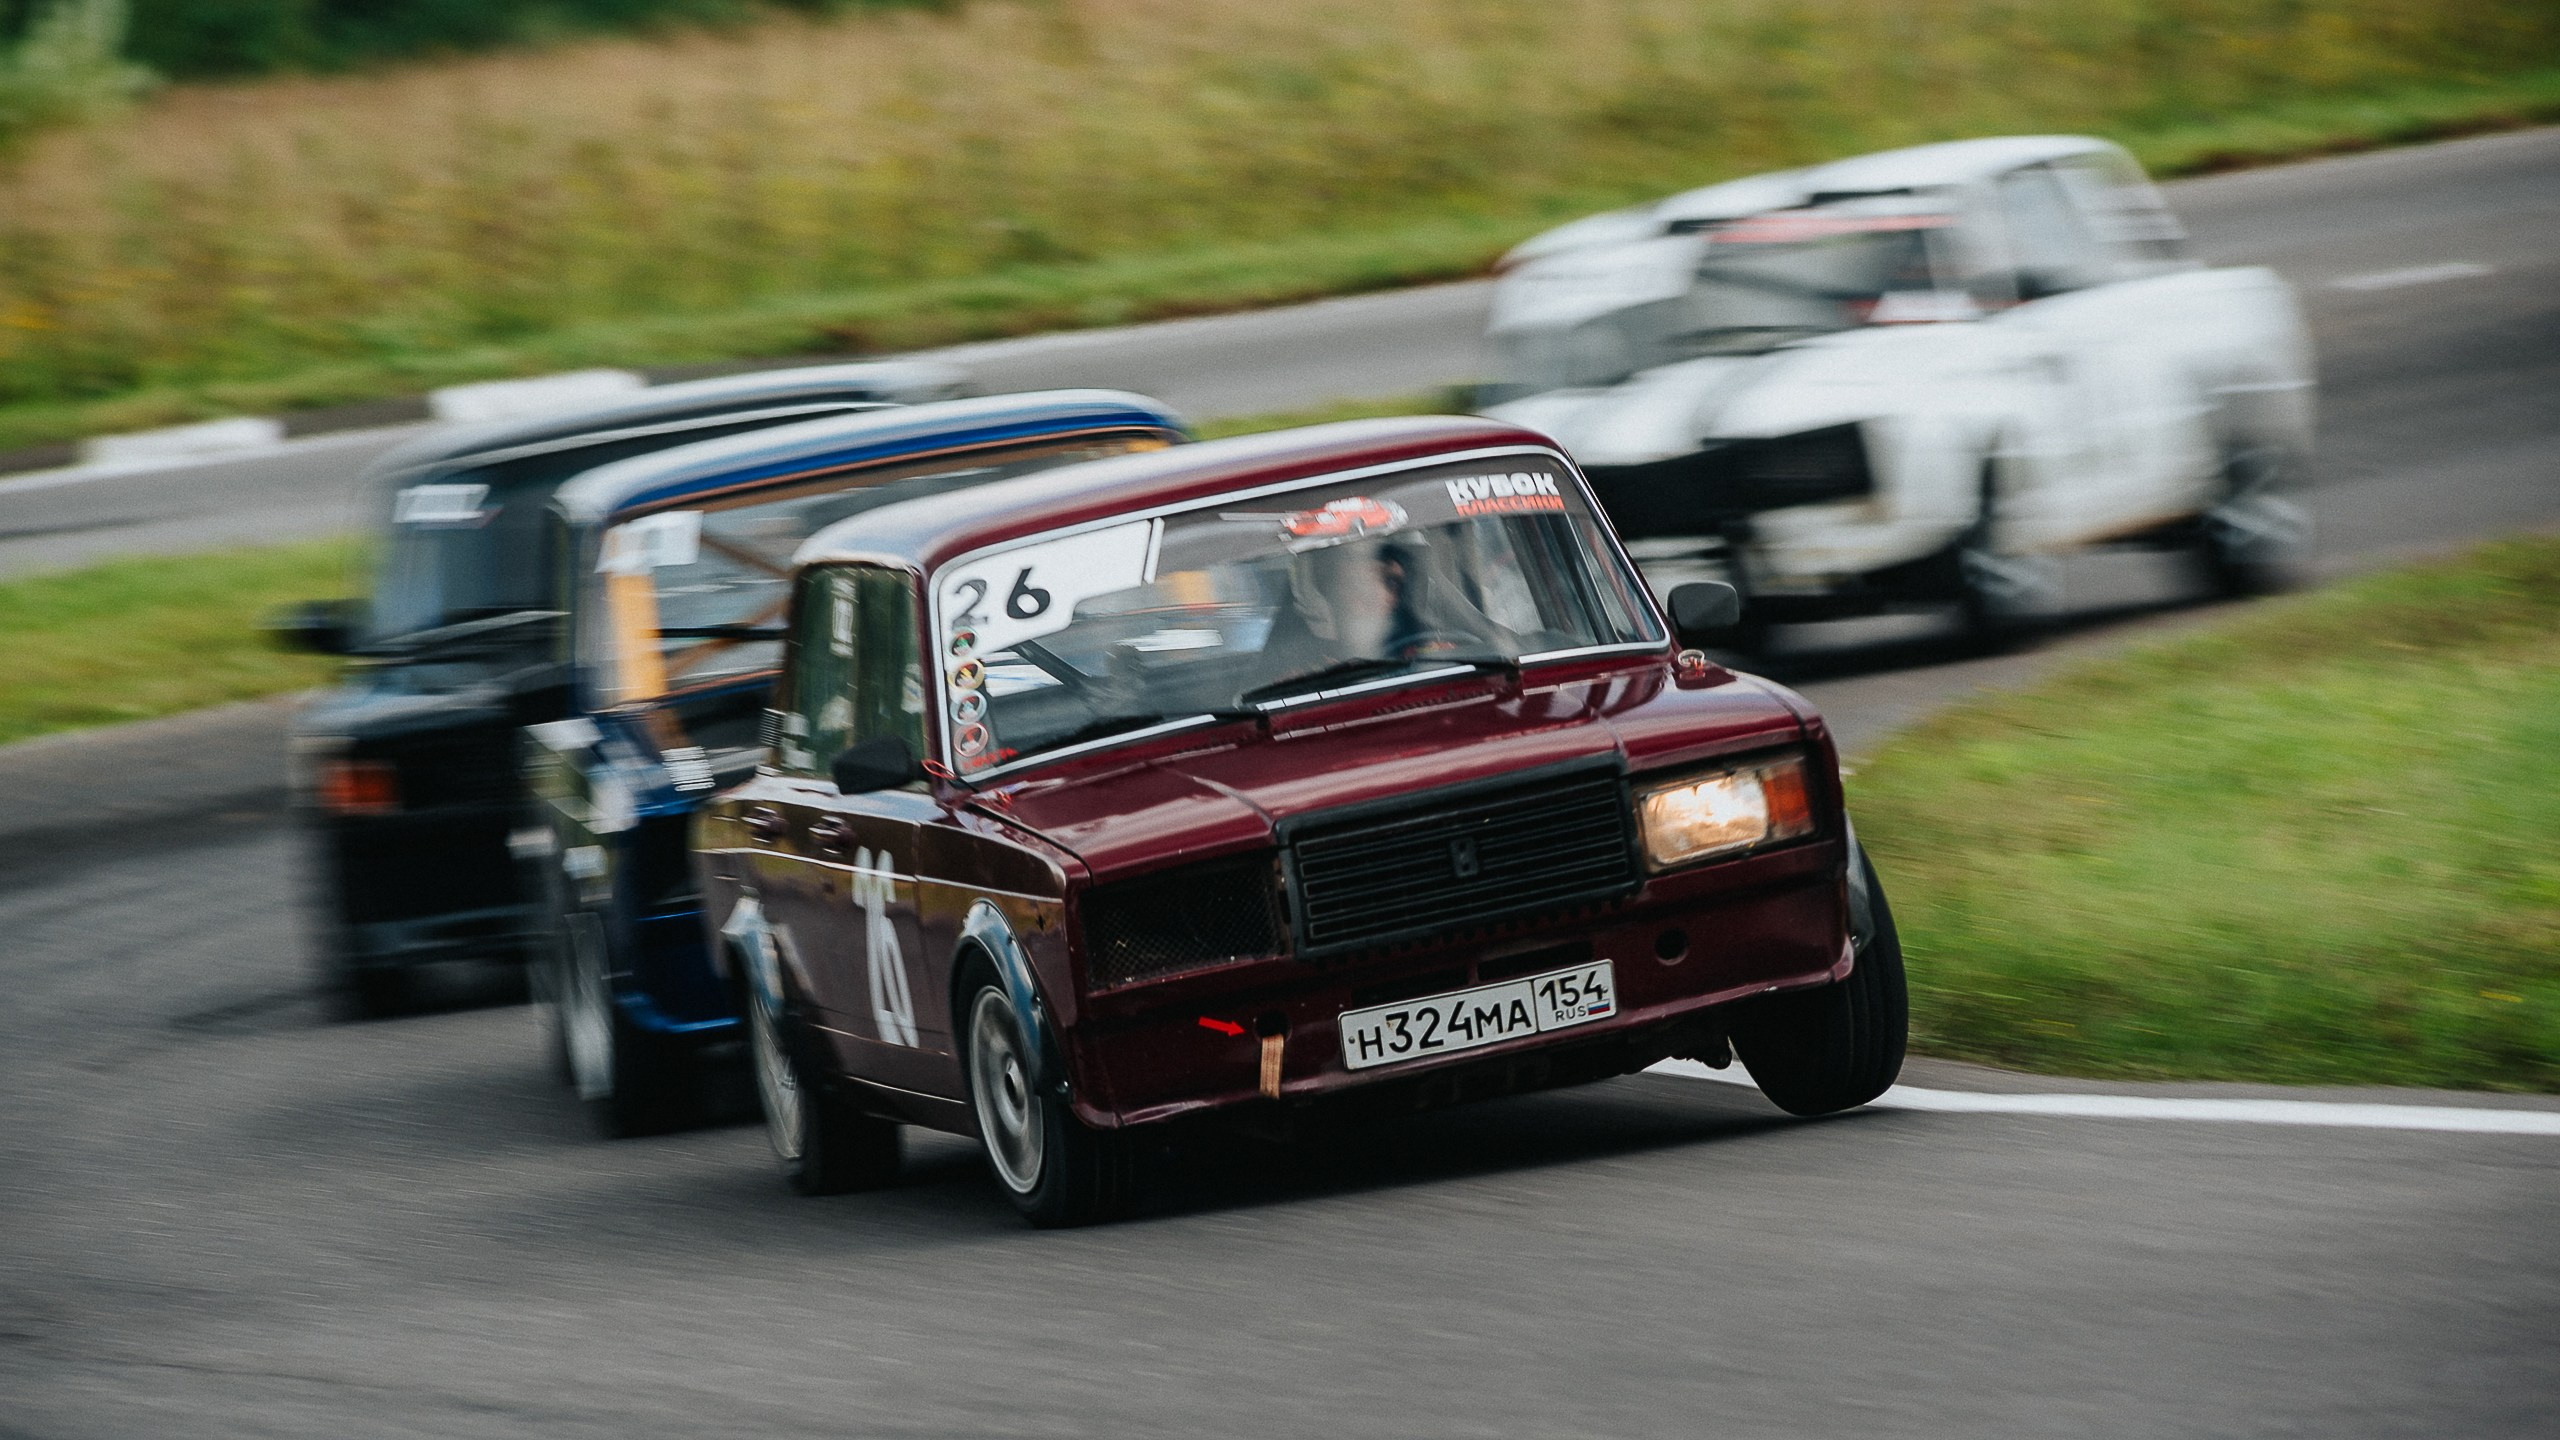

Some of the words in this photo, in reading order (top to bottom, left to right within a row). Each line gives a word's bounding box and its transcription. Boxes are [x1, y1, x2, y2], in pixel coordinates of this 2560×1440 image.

[1444, 472, 1560, 506] КУБОК
[951, 566, 1051, 629] 26
[851, 845, 920, 1050] 26
[1357, 1000, 1532, 1060] Н324МА
[1539, 970, 1604, 1011] 154
[1555, 1005, 1587, 1022] RUS
